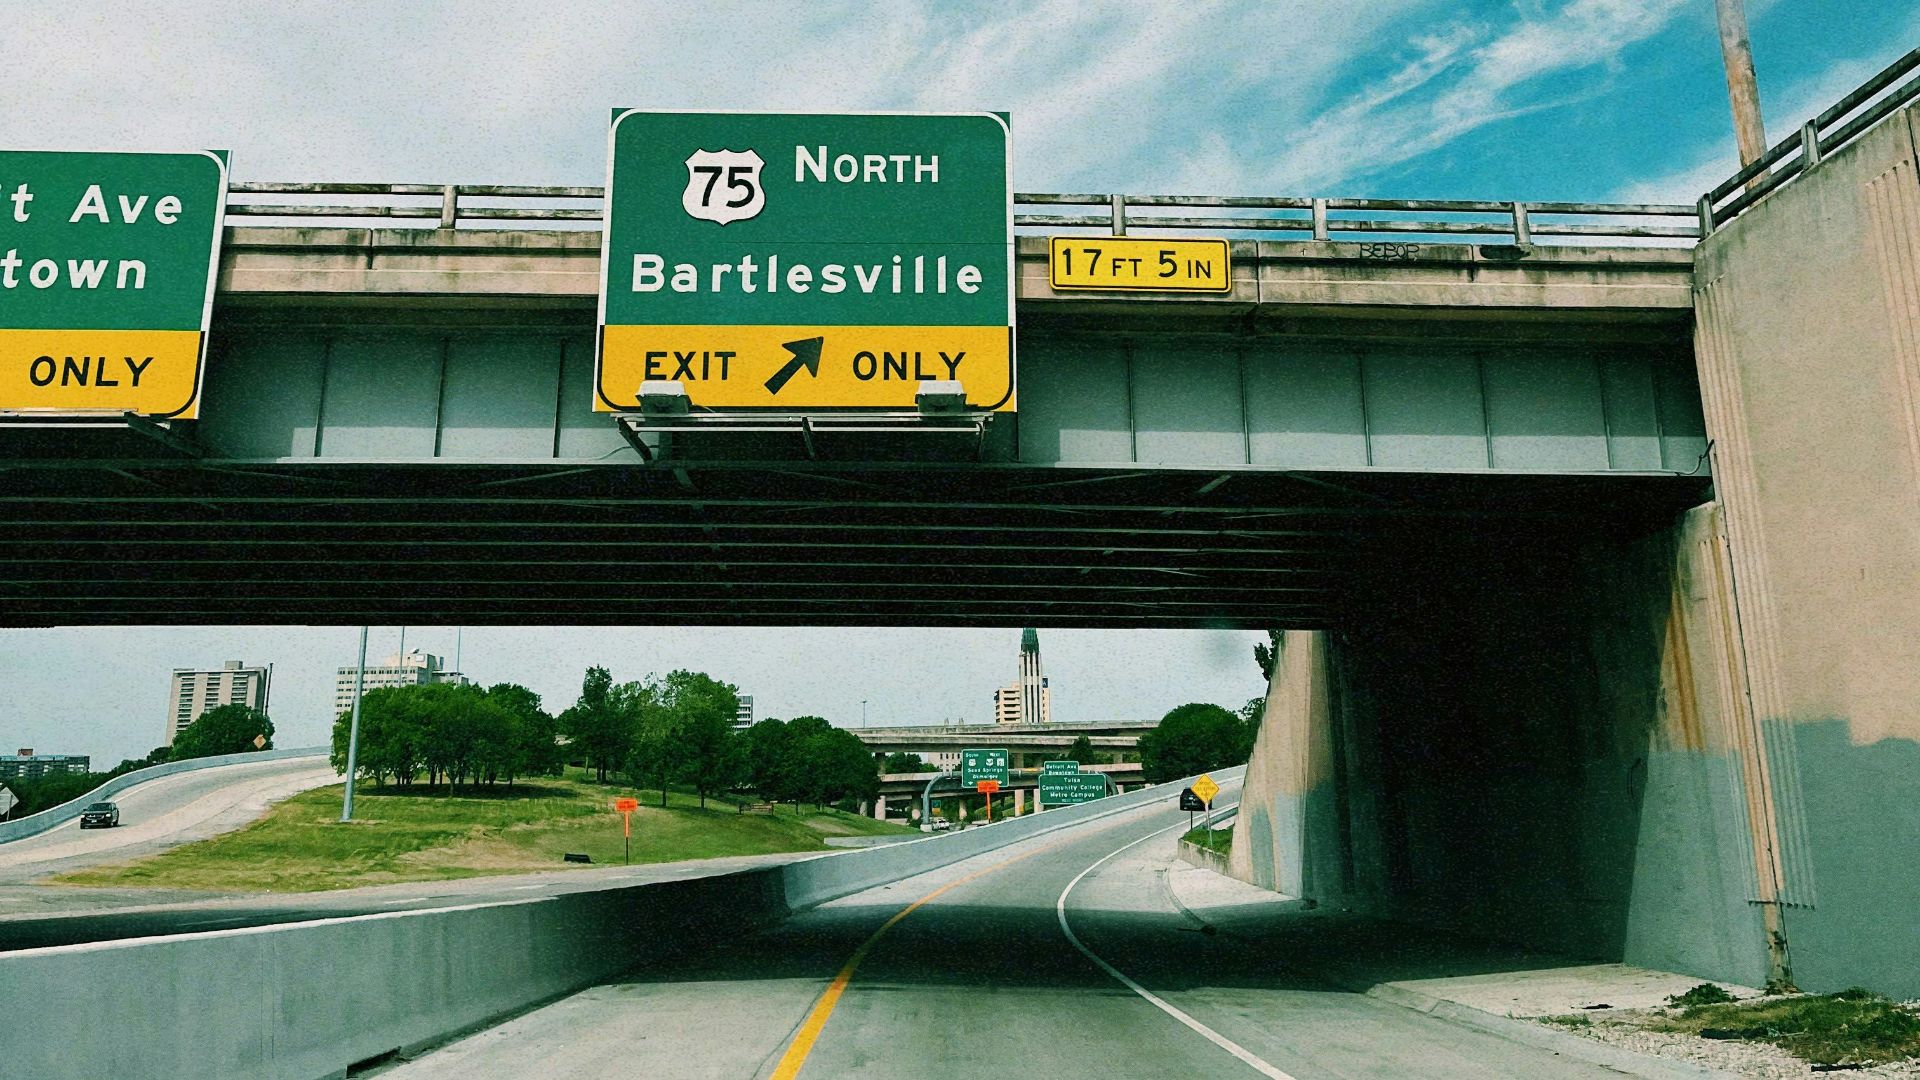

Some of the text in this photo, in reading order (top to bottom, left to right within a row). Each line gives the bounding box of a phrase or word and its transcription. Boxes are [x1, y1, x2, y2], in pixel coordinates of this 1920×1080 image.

[795, 145, 939, 183] NORTH
[69, 184, 182, 224] Ave
[694, 166, 756, 209] 75
[1062, 248, 1211, 279] 17 FT 5 IN
[1360, 242, 1420, 260] BEBOP
[632, 253, 982, 294] Bartlesville
[29, 355, 154, 387] ONLY
[645, 351, 966, 381] EXIT ONLY
